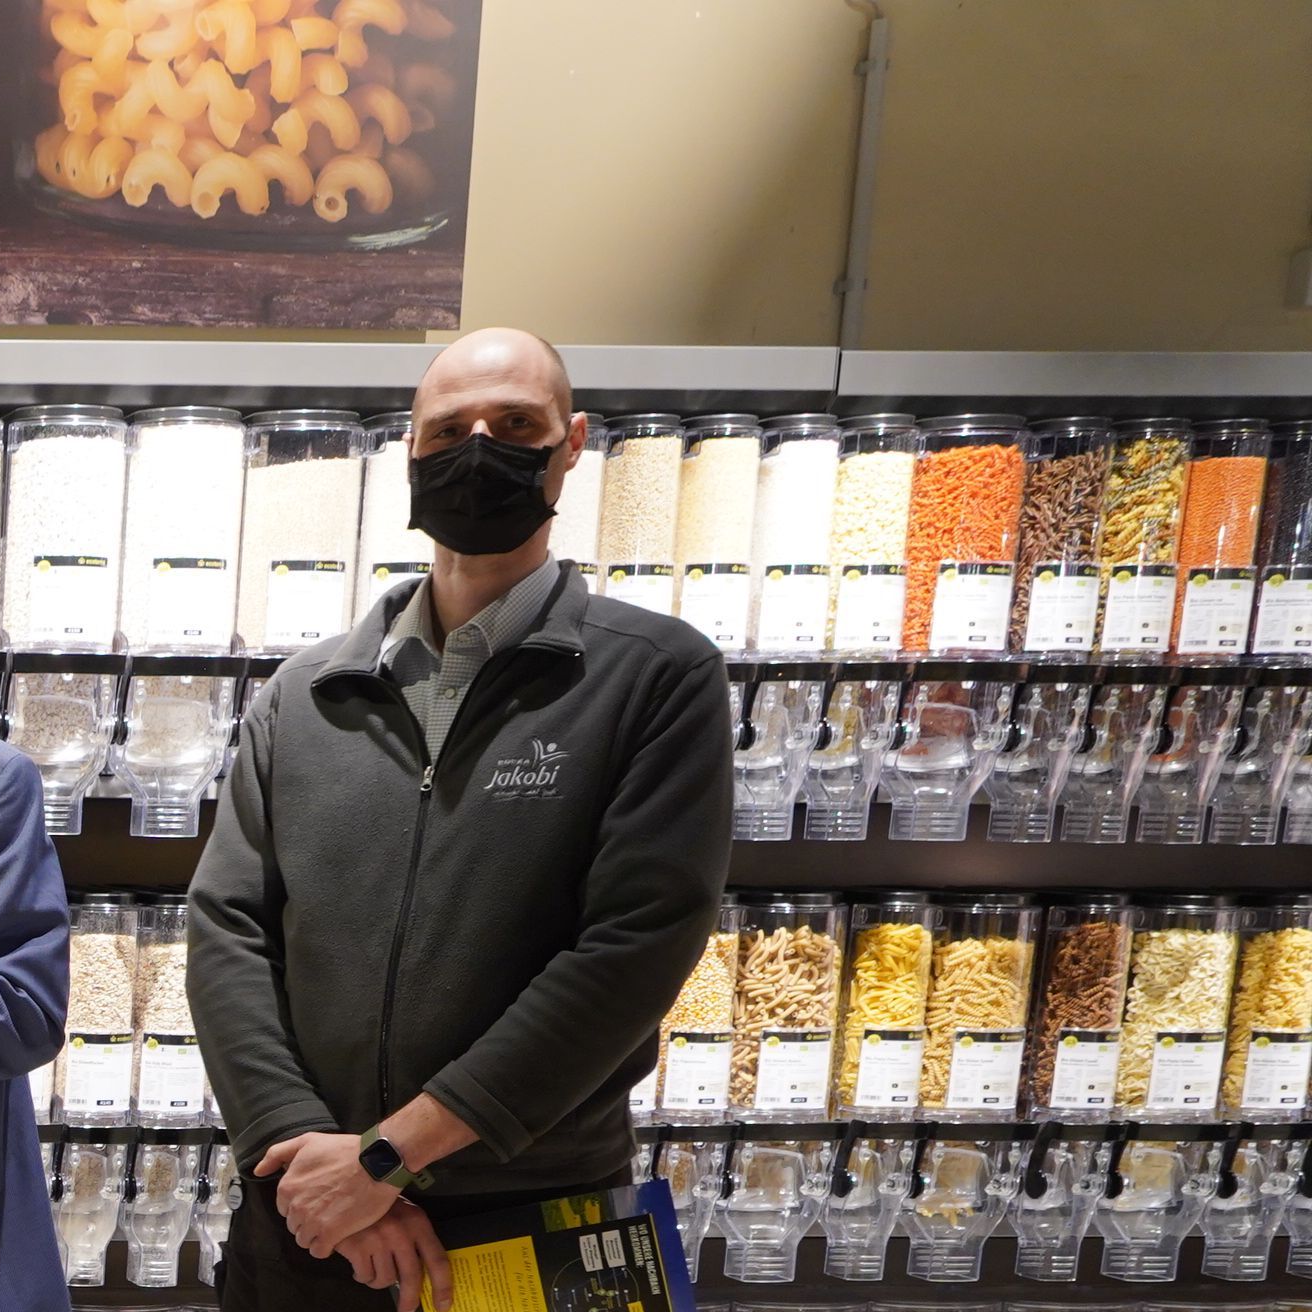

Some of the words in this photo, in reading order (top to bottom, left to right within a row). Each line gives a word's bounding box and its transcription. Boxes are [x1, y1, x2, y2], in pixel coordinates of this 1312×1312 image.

[483, 765, 560, 789] Jakobi
[640, 1235, 653, 1261] UNSERE
[645, 1261, 661, 1295] NACHBARN
